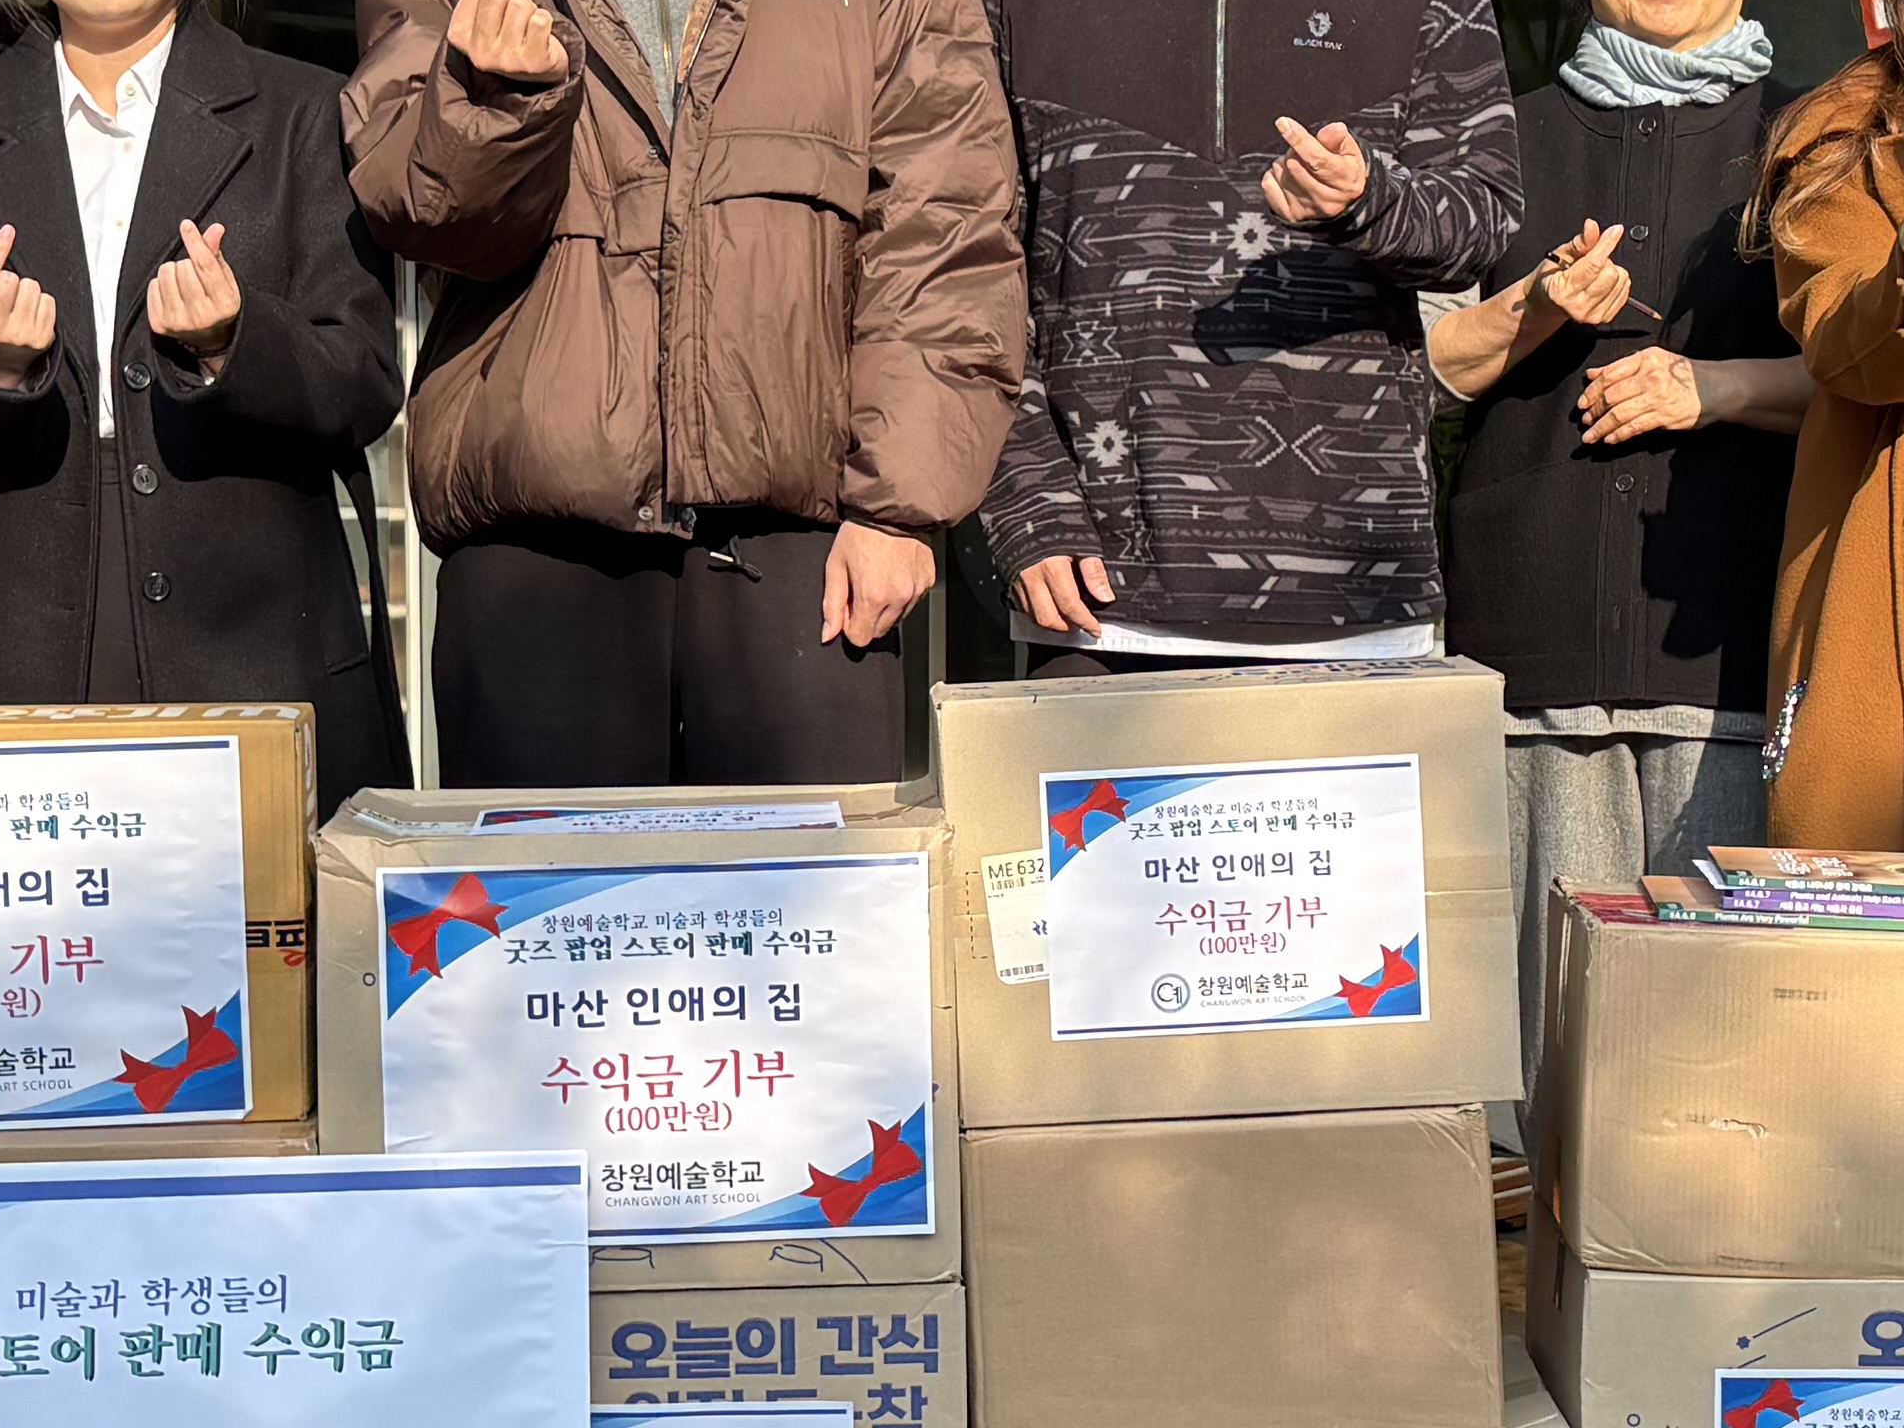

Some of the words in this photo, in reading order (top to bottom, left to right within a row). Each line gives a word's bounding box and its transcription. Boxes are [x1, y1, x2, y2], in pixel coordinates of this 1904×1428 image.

[19, 792, 88, 811] 학생들의
[10, 815, 58, 840] 판매
[70, 812, 146, 839] 수익금
[1129, 823, 1164, 840] 굿즈
[1208, 816, 1257, 834] 스토어
[1266, 815, 1297, 832] 판매
[1306, 812, 1354, 830] 수익금
[988, 862, 1014, 880] ME
[1145, 857, 1200, 883] 마산
[1212, 852, 1293, 881] 인애의
[1309, 850, 1331, 876] 집
[76, 868, 109, 906] 집
[543, 913, 648, 934] 창원예술학교
[656, 911, 706, 930] 미술과
[714, 908, 782, 928] 학생들의
[1155, 900, 1253, 935] 수익금
[1266, 896, 1327, 930] 기부
[10, 935, 103, 984] 기부
[504, 940, 556, 964] 굿즈
[565, 935, 611, 961] 팝업
[621, 933, 694, 958] 스토어
[705, 931, 752, 956] 판매
[763, 929, 837, 956] 수익금
[1200, 932, 1286, 955] (100만원)
[1198, 973, 1308, 996] 창원예술학교
[528, 990, 608, 1028] 마산
[627, 986, 745, 1025] 인애의
[768, 984, 800, 1021] 집
[23, 1080, 72, 1091] SCHOOL
[542, 1054, 684, 1104] 수익금
[704, 1050, 794, 1097] 기부
[605, 1101, 732, 1134] (100만원)
[602, 1161, 764, 1191] 창원예술학교
[606, 1196, 680, 1207] CHANGWON
[685, 1195, 707, 1204] ART
[712, 1193, 760, 1204] SCHOOL
[16, 1279, 126, 1321] 미술과
[141, 1275, 286, 1316] 학생들의
[119, 1322, 221, 1377] 판매
[243, 1318, 403, 1375] 수익금
[609, 1316, 796, 1380] 오늘의
[817, 1313, 939, 1375] 간식
